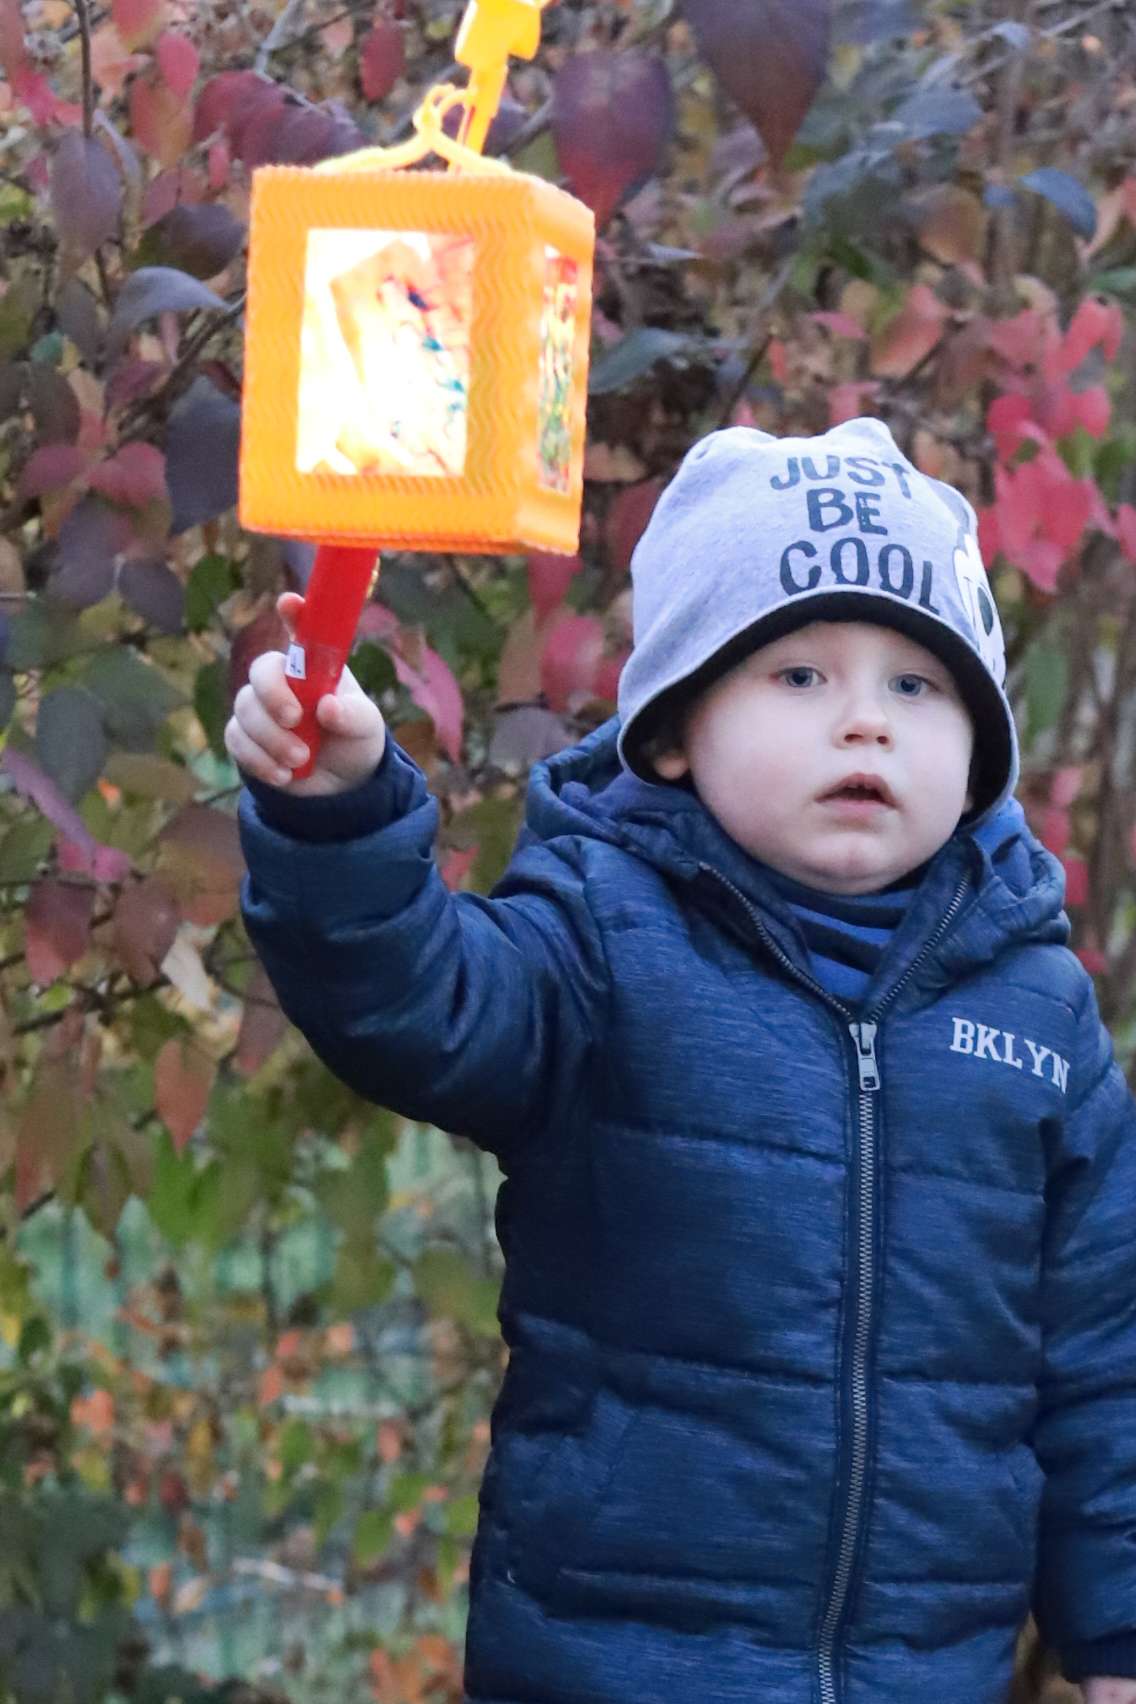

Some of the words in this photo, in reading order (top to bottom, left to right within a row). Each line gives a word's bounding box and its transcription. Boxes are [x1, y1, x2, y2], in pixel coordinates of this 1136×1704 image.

[770, 455, 912, 499] JUST
[806, 488, 888, 535] BE
[779, 537, 940, 615] COOL
[949, 1017, 1070, 1094] BKLYN
